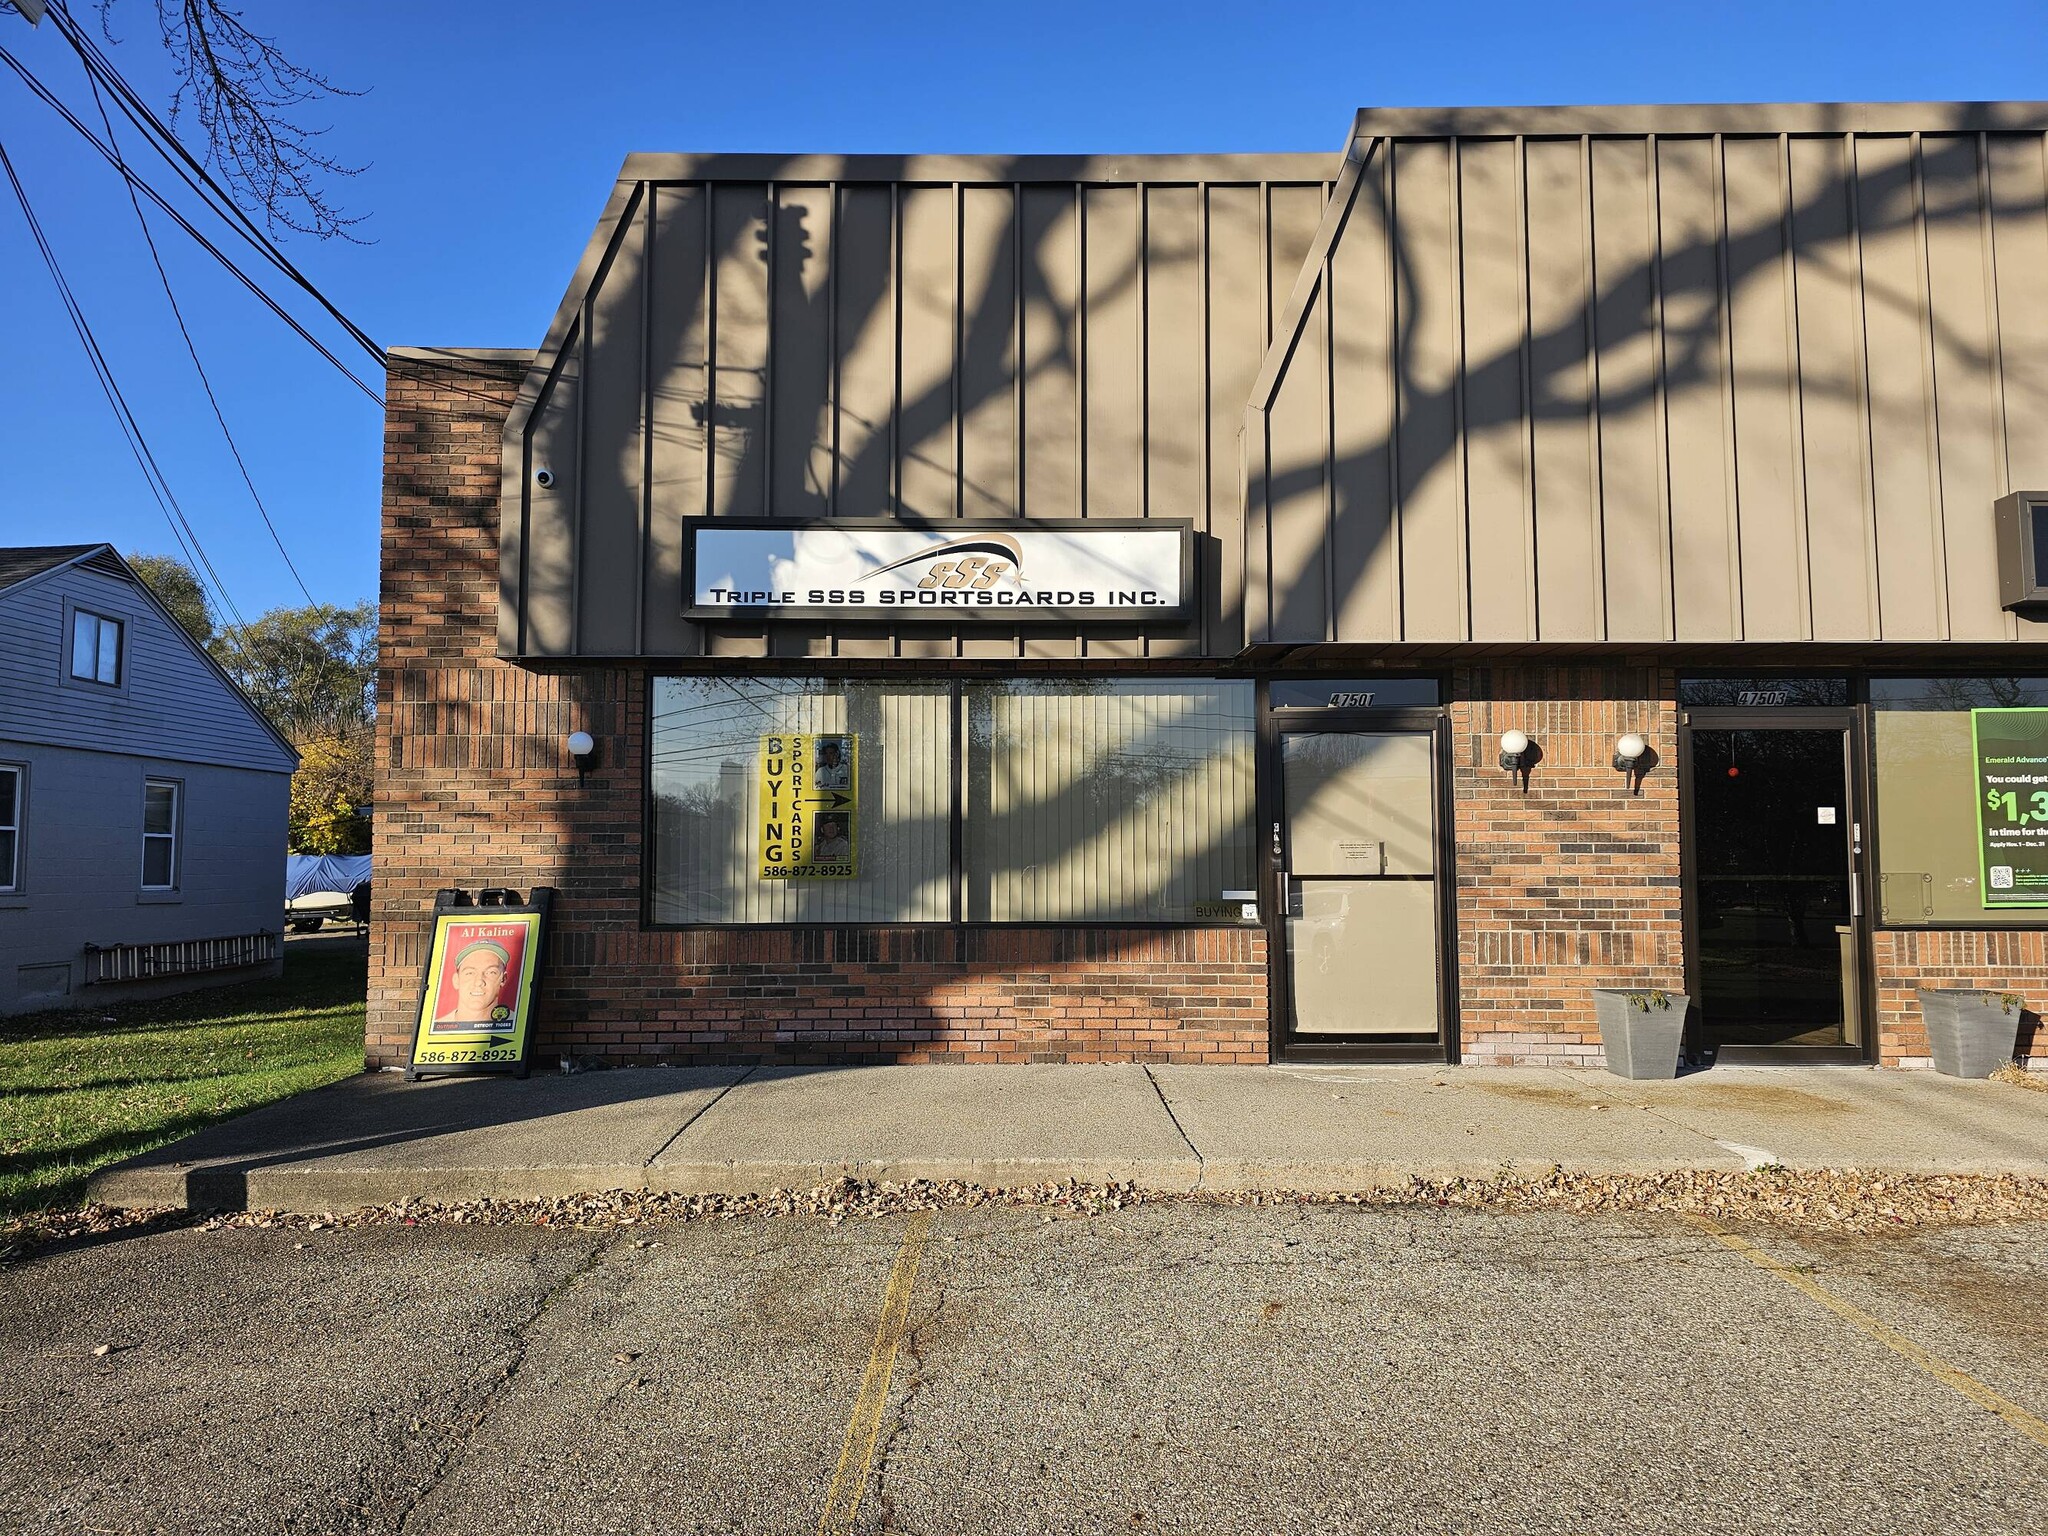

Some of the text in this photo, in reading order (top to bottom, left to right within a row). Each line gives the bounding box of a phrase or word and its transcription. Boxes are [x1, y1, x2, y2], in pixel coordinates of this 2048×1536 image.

[709, 588, 1166, 606] TRIPLE SSS SPORTSCARDS INC.
[1329, 693, 1375, 707] 47501
[1738, 692, 1786, 705] 47503
[1985, 756, 2047, 764] Emerald Advance
[1986, 774, 2048, 785] You could get
[765, 737, 783, 862] BUYING
[791, 737, 803, 861] SPORTCARDS
[1989, 827, 2048, 836] in time for th
[763, 865, 852, 877] 586-872-8925
[1195, 906, 1242, 918] BUYING
[461, 926, 515, 938] Al Kaline
[419, 1049, 517, 1063] 586-872-8925
